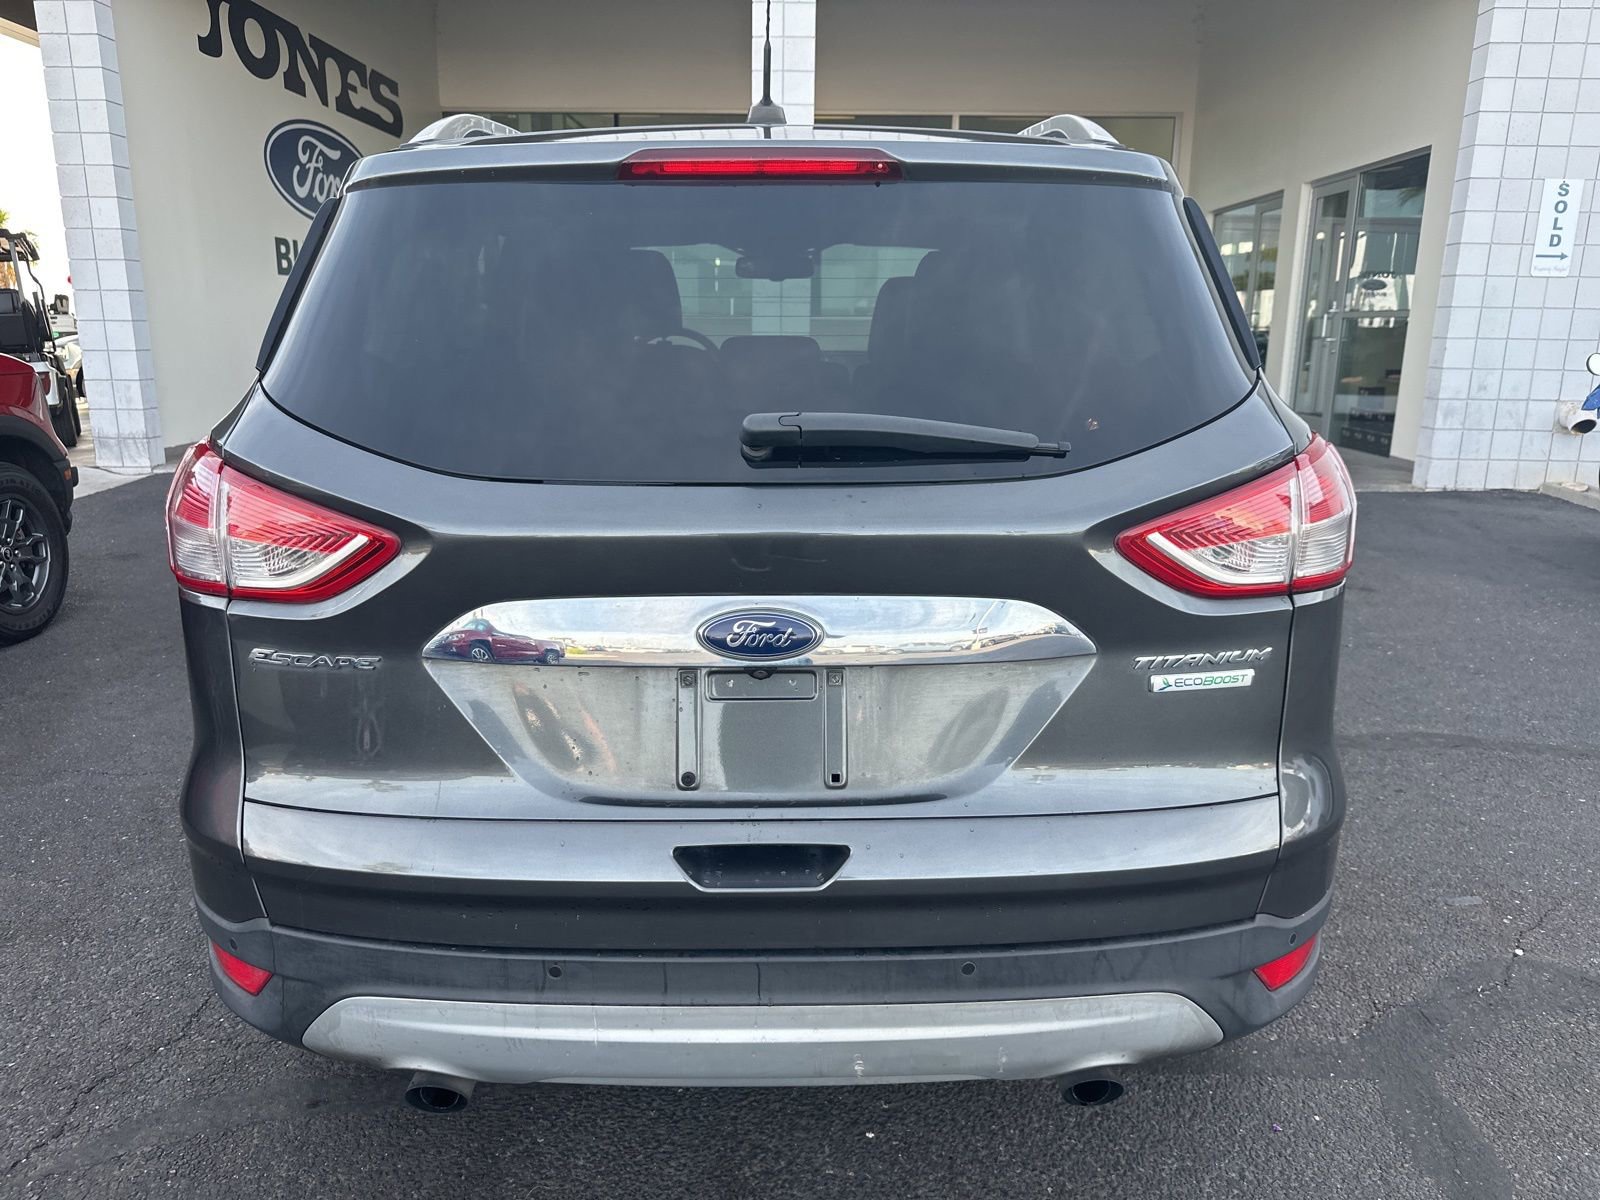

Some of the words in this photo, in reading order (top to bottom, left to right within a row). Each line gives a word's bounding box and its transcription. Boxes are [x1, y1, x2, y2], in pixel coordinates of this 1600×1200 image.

[197, 0, 404, 138] JONES
[292, 135, 342, 204] For
[1548, 183, 1570, 248] SOLD
[726, 620, 796, 648] Ford
[248, 647, 382, 671] ESCAPE
[1133, 647, 1273, 670] TITANIUM
[1174, 673, 1249, 688] ECOBOOST
